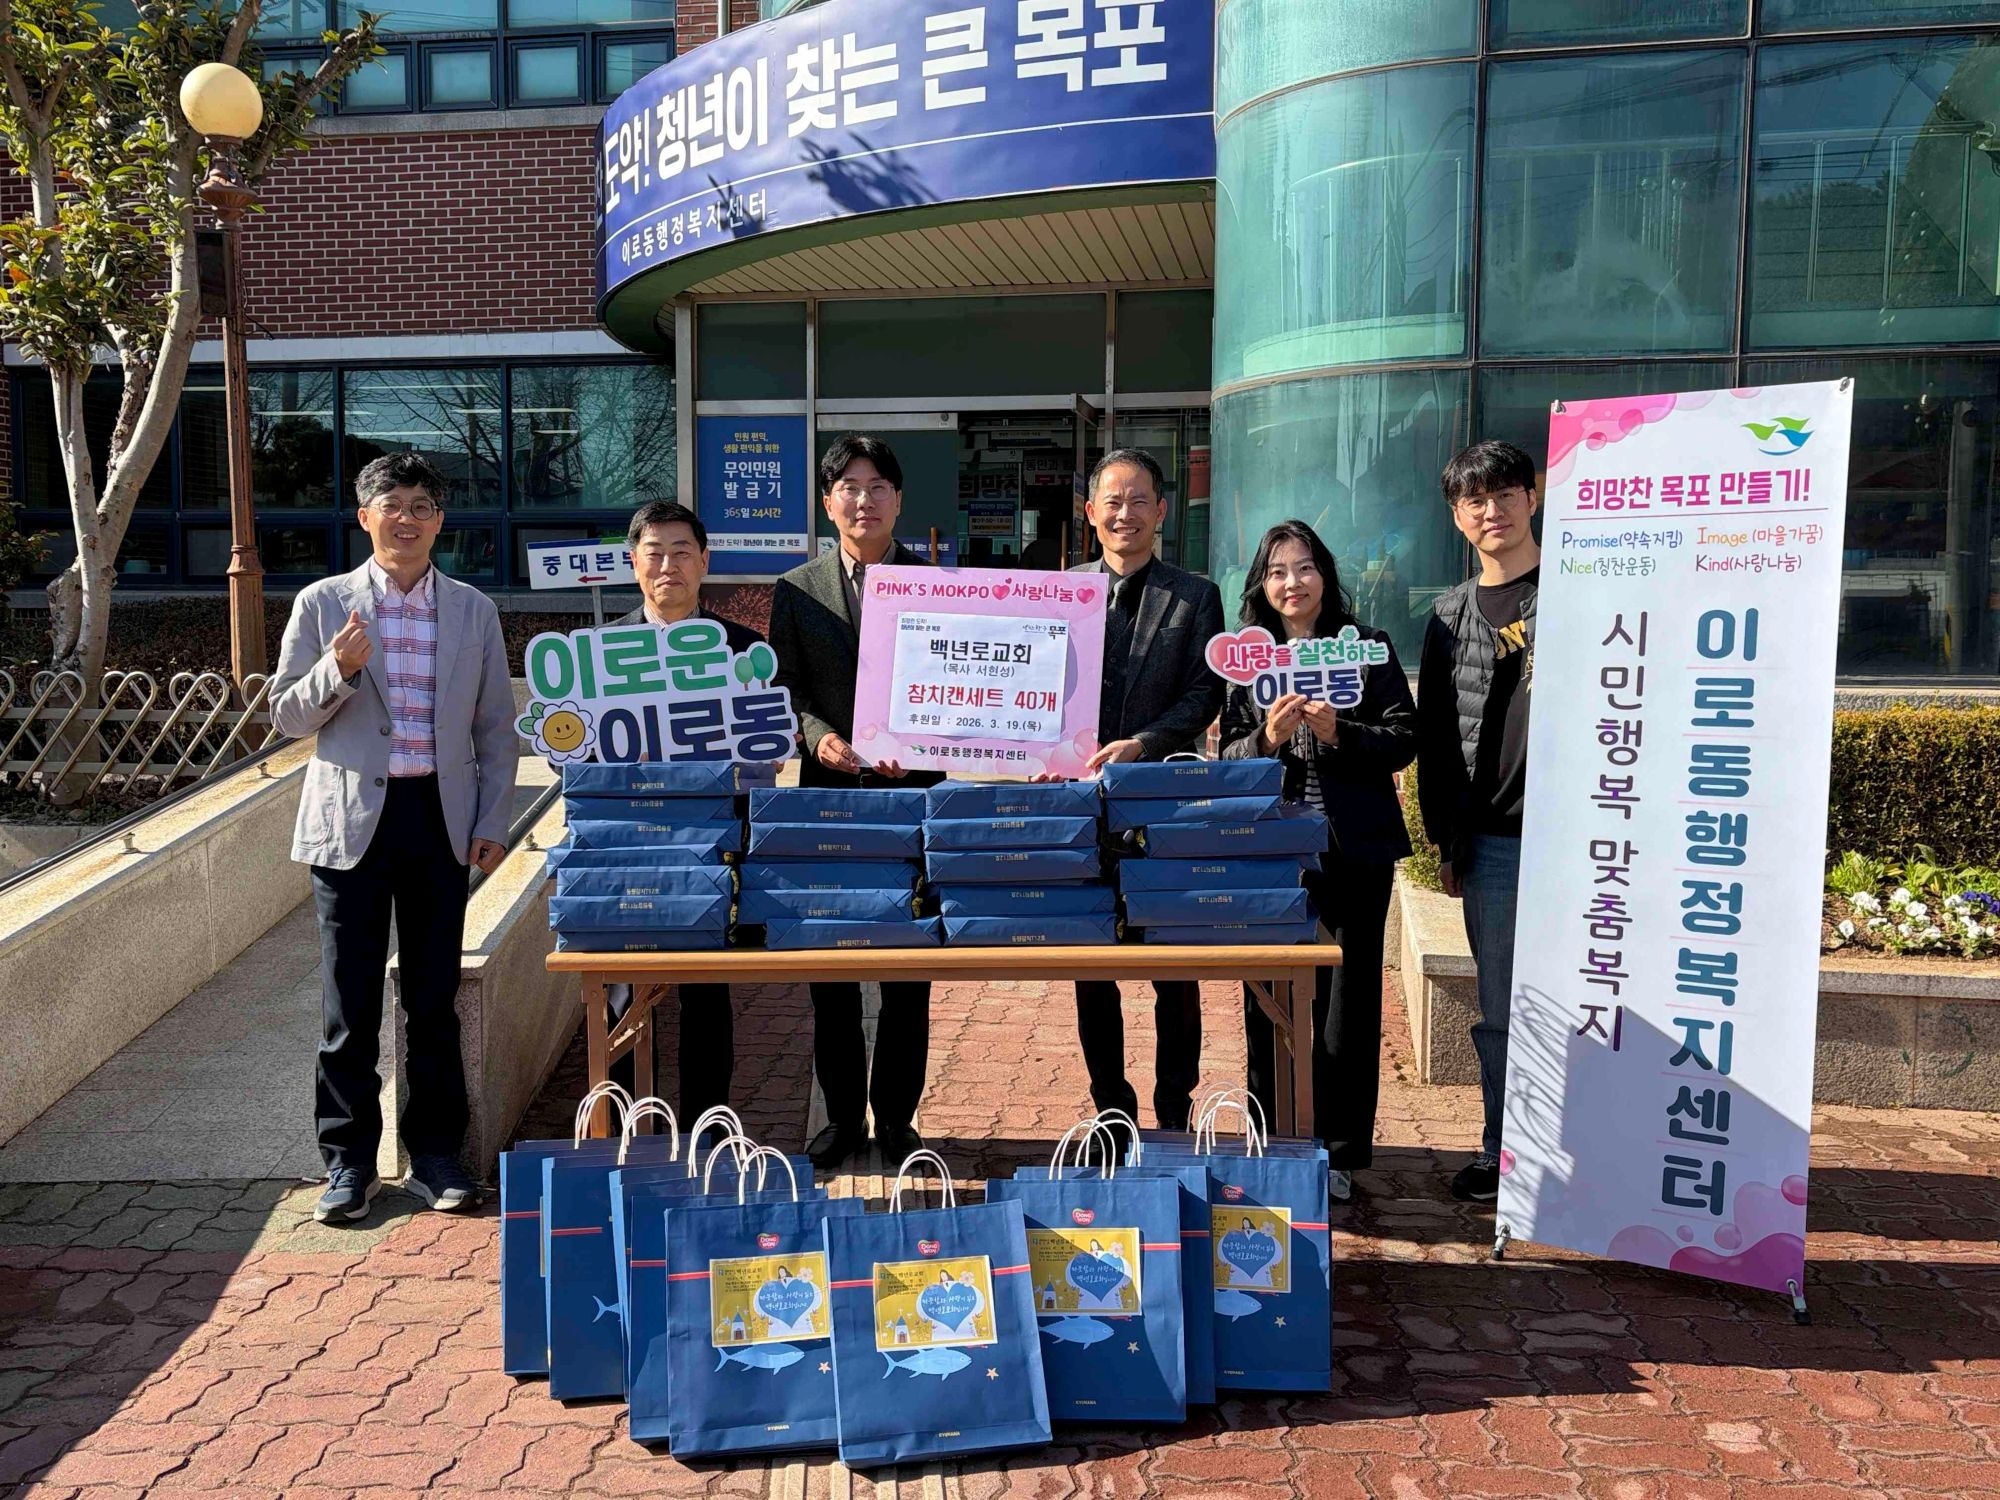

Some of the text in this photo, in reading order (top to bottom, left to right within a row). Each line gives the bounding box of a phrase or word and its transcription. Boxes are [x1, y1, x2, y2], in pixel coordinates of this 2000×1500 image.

[605, 108, 650, 214] 도약!
[656, 56, 767, 180] 청년이
[786, 32, 899, 138] 찾는
[922, 6, 989, 111] 큰
[1014, 0, 1167, 92] 목포
[622, 189, 766, 266] 이로동행정복지센터
[724, 461, 781, 478] 무인민원
[1577, 468, 1811, 511] 희망찬 목포 만들기!
[724, 507, 781, 519] 365일 24시간
[1562, 524, 1823, 549] Promise(약속지킴) Image (마을가꿈)
[1560, 553, 1802, 576] Nice(칭찬운동) Kind(사랑나눔)
[931, 583, 989, 598] MOKPO
[1012, 582, 1074, 603] 사랑나눔
[1048, 625, 1066, 640] 목포
[531, 624, 728, 699] 이로운
[930, 639, 1032, 665] 백년로교회
[1225, 639, 1386, 670] 사랑을 실천하는
[943, 663, 1015, 678] (목사 서현성)
[907, 684, 1057, 712] 참치캔세트 40개
[1256, 669, 1360, 705] 이로동
[600, 692, 792, 763] 이로동
[908, 713, 941, 726] 후원일
[956, 716, 985, 728] 2026.
[990, 718, 1000, 729] 3.
[1006, 719, 1042, 732] 19.(목)
[929, 745, 1027, 761] 이로동행정복지센터
[1576, 611, 1648, 1052] 시민행복 맞춤복지
[1661, 607, 1760, 1217] 이로동행정복지센터
